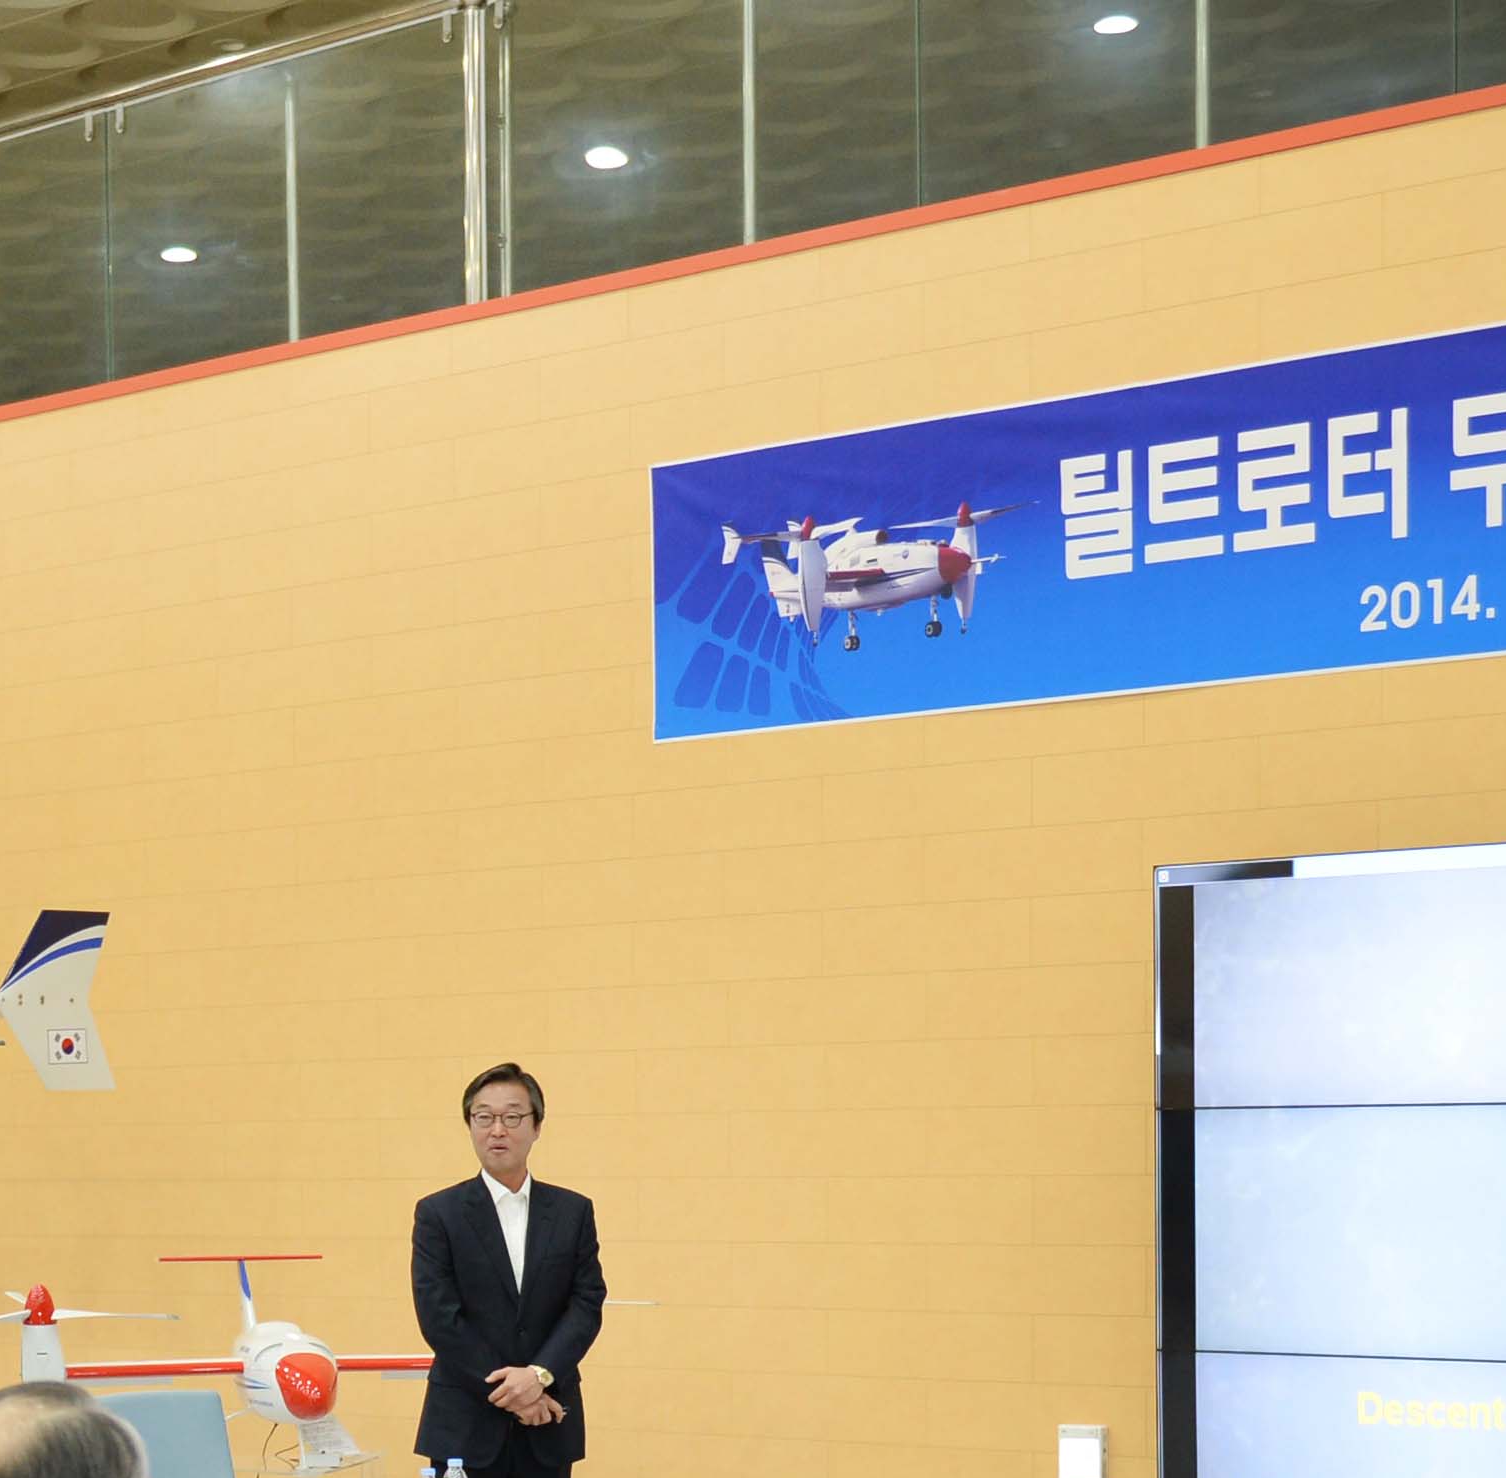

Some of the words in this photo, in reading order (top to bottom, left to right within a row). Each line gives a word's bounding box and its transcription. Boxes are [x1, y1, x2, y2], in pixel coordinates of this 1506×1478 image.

[1058, 407, 1410, 581] 틸트로터
[1359, 574, 1497, 633] 2014.
[1356, 1391, 1506, 1430] Descent
